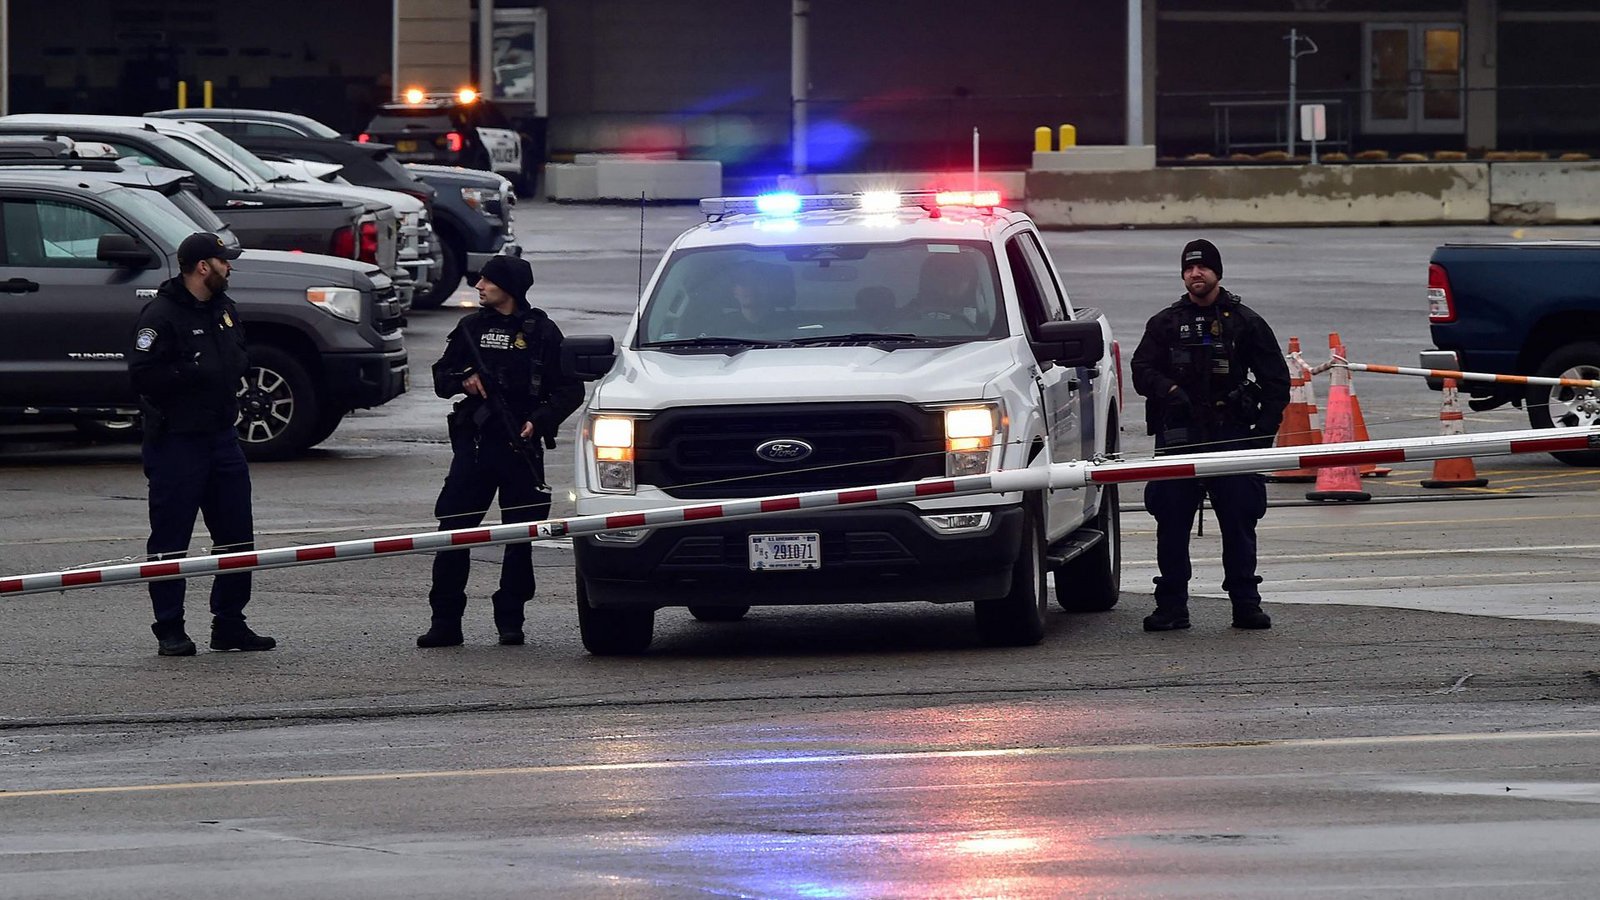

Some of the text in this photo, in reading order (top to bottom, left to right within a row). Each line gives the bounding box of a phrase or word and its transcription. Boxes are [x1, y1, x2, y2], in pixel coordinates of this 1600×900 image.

[481, 333, 510, 342] POLICE
[770, 445, 799, 457] Ford
[774, 543, 813, 560] 291071
